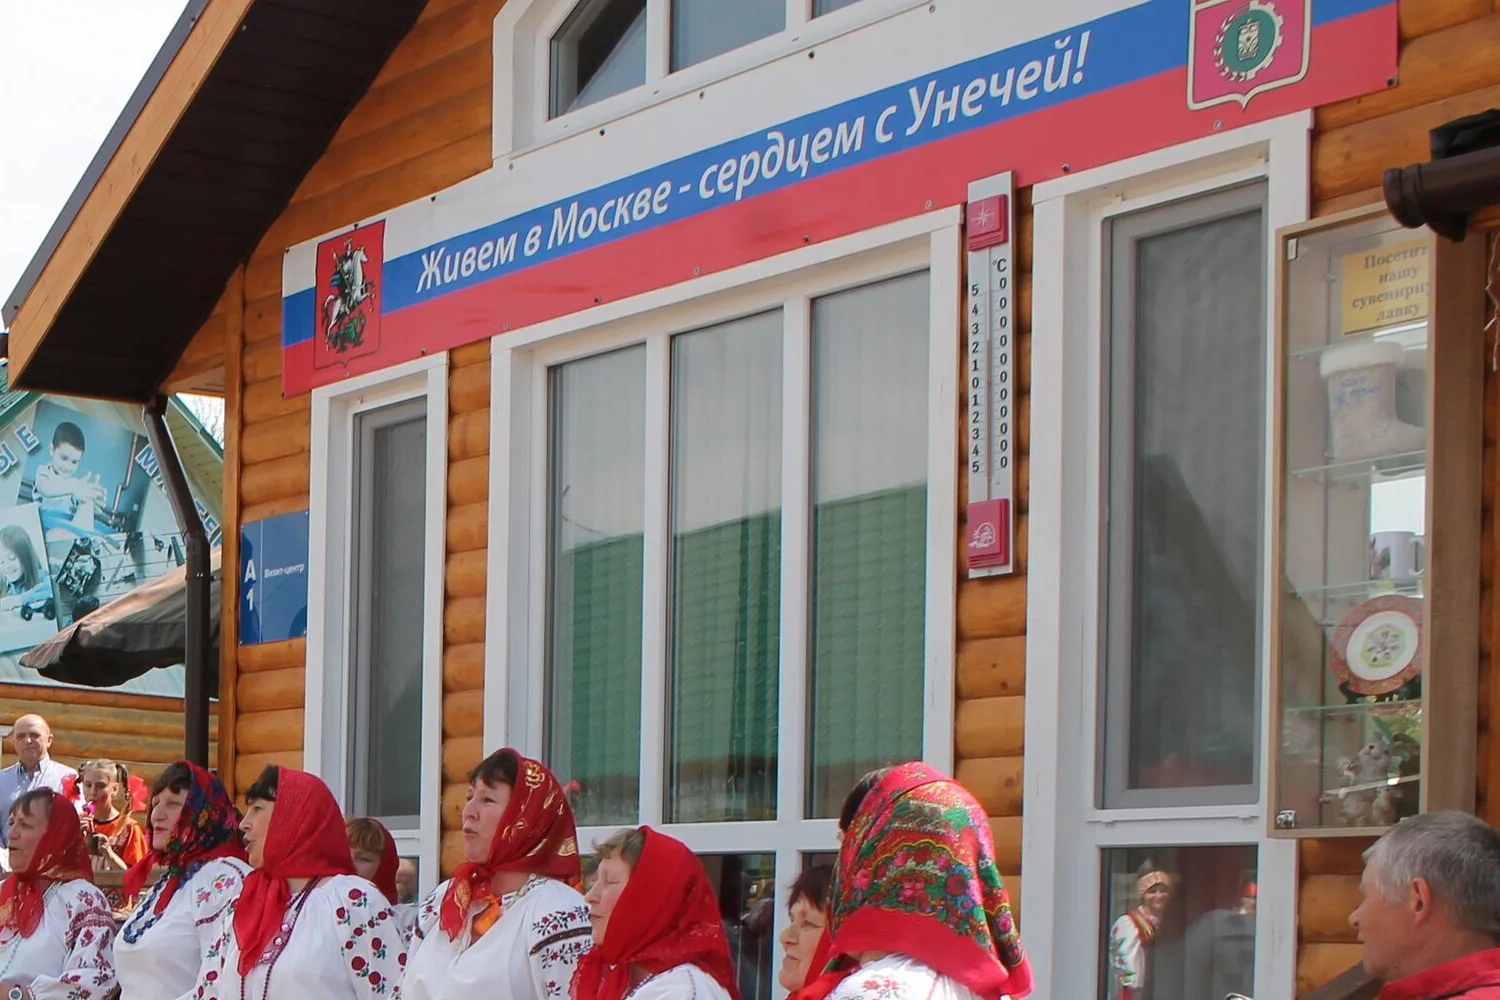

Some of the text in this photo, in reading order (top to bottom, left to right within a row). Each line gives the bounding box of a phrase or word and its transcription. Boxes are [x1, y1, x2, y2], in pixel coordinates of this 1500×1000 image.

[417, 232, 518, 292] Живем
[523, 225, 542, 256] в
[547, 180, 672, 250] Москве
[699, 116, 865, 201] сердцем
[875, 105, 897, 143] с
[906, 30, 1091, 135] Унечей!
[1379, 264, 1421, 284] нашу
[1376, 302, 1422, 322] лавку
[243, 558, 258, 584] А
[245, 586, 256, 612] 1
